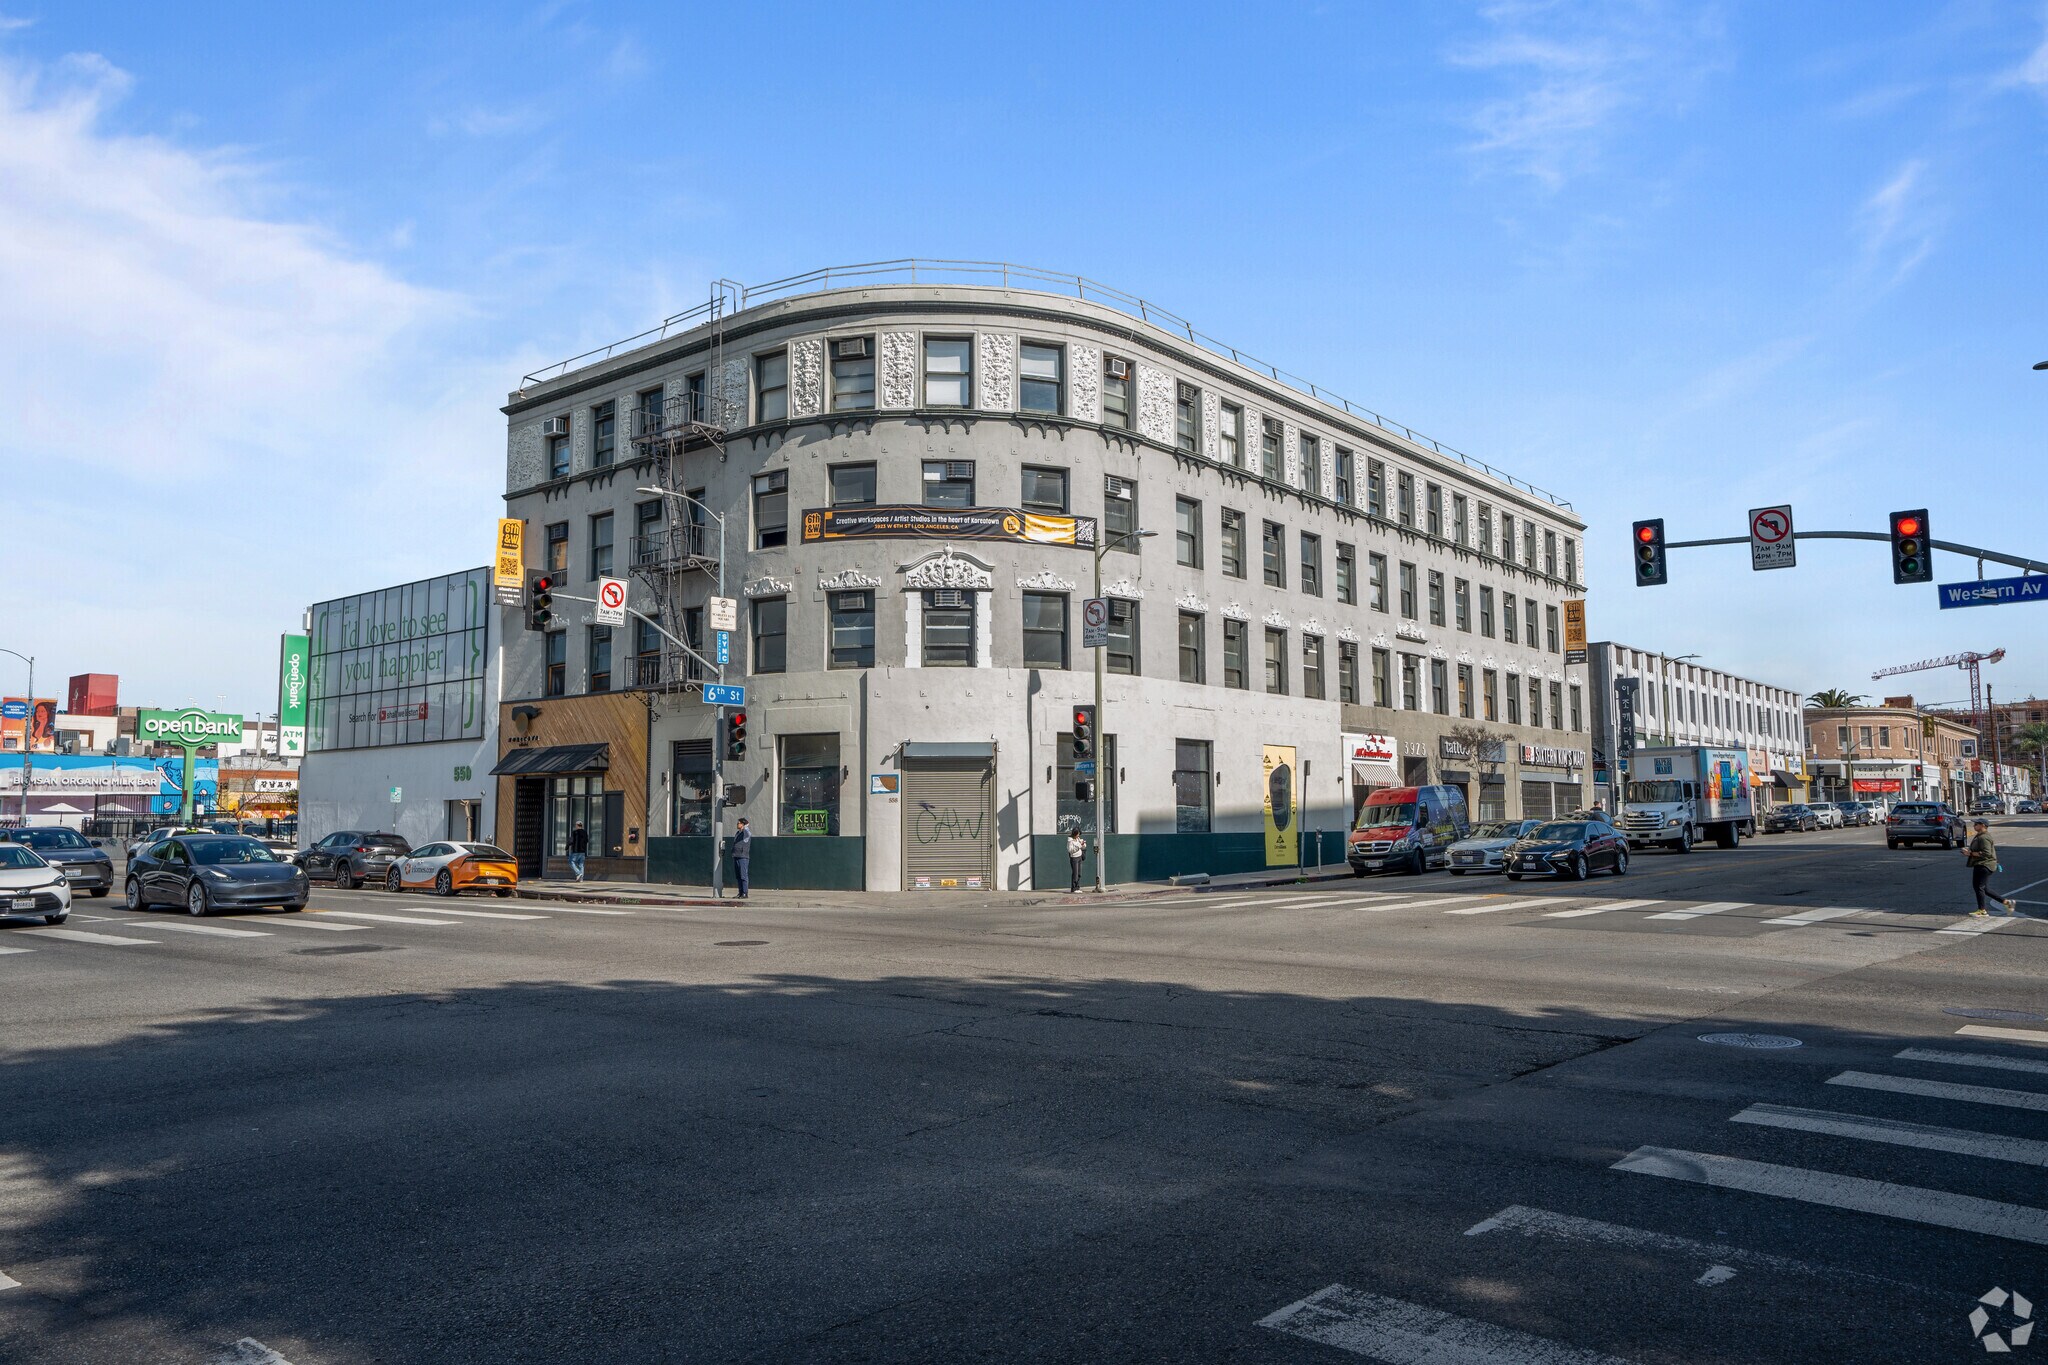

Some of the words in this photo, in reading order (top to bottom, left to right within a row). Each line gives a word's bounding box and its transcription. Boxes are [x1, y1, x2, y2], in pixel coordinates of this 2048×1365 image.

[808, 514, 820, 524] 6th
[858, 516, 889, 524] Workspaces
[948, 516, 963, 524] heart
[971, 517, 1000, 525] Koreatown
[505, 523, 519, 534] 6th
[504, 534, 519, 545] &W
[2021, 582, 2042, 595] Av
[343, 620, 358, 649] I'd
[365, 618, 396, 645] love
[402, 615, 418, 639] to
[420, 612, 446, 636] see
[345, 661, 371, 690] you
[378, 643, 444, 683] happier
[708, 686, 725, 701] 6th
[730, 690, 740, 701] St
[349, 711, 366, 723] Search
[367, 711, 377, 721] for
[283, 730, 303, 738] ATM
[1404, 741, 1426, 756] 3923
[1558, 748, 1572, 767] KIM'S
[1572, 750, 1586, 768] MART
[453, 765, 472, 782] 550
[61, 776, 108, 787] ORGANIC
[111, 777, 134, 787] MILK
[136, 777, 157, 788] BAR
[797, 814, 825, 823] KELLY
